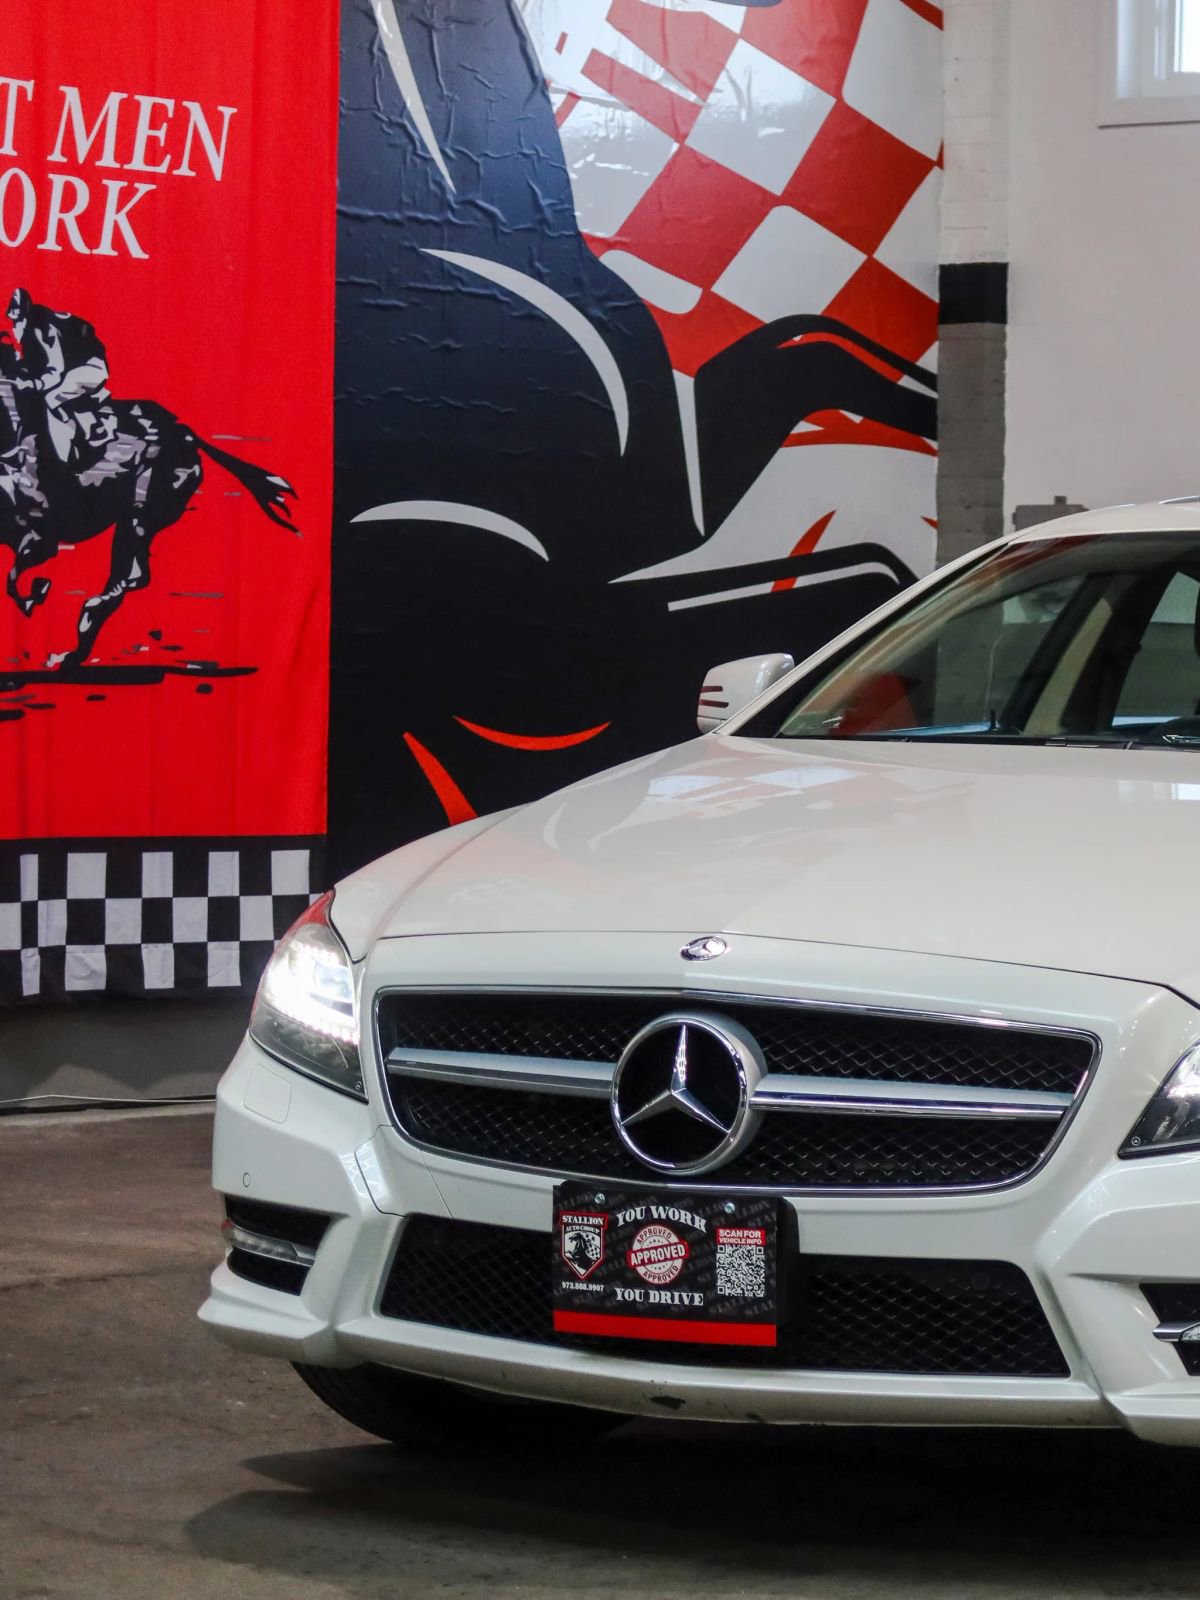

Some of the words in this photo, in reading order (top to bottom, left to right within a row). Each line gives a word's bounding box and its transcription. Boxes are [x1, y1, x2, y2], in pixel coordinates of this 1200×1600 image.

[47, 85, 238, 181] MEN
[562, 1215, 604, 1225] STALLION
[616, 1207, 646, 1227] YOU
[650, 1205, 707, 1233] WORK
[580, 1225, 600, 1234] GROUP
[637, 1227, 672, 1244] APPROVED
[719, 1229, 743, 1238] SCAN
[743, 1230, 761, 1239] FOR
[719, 1237, 746, 1245] VEHICLE
[630, 1244, 686, 1266] APPROVED
[643, 1265, 679, 1282] APPROVED
[614, 1287, 645, 1302] YOU
[648, 1290, 704, 1306] DRIVE
